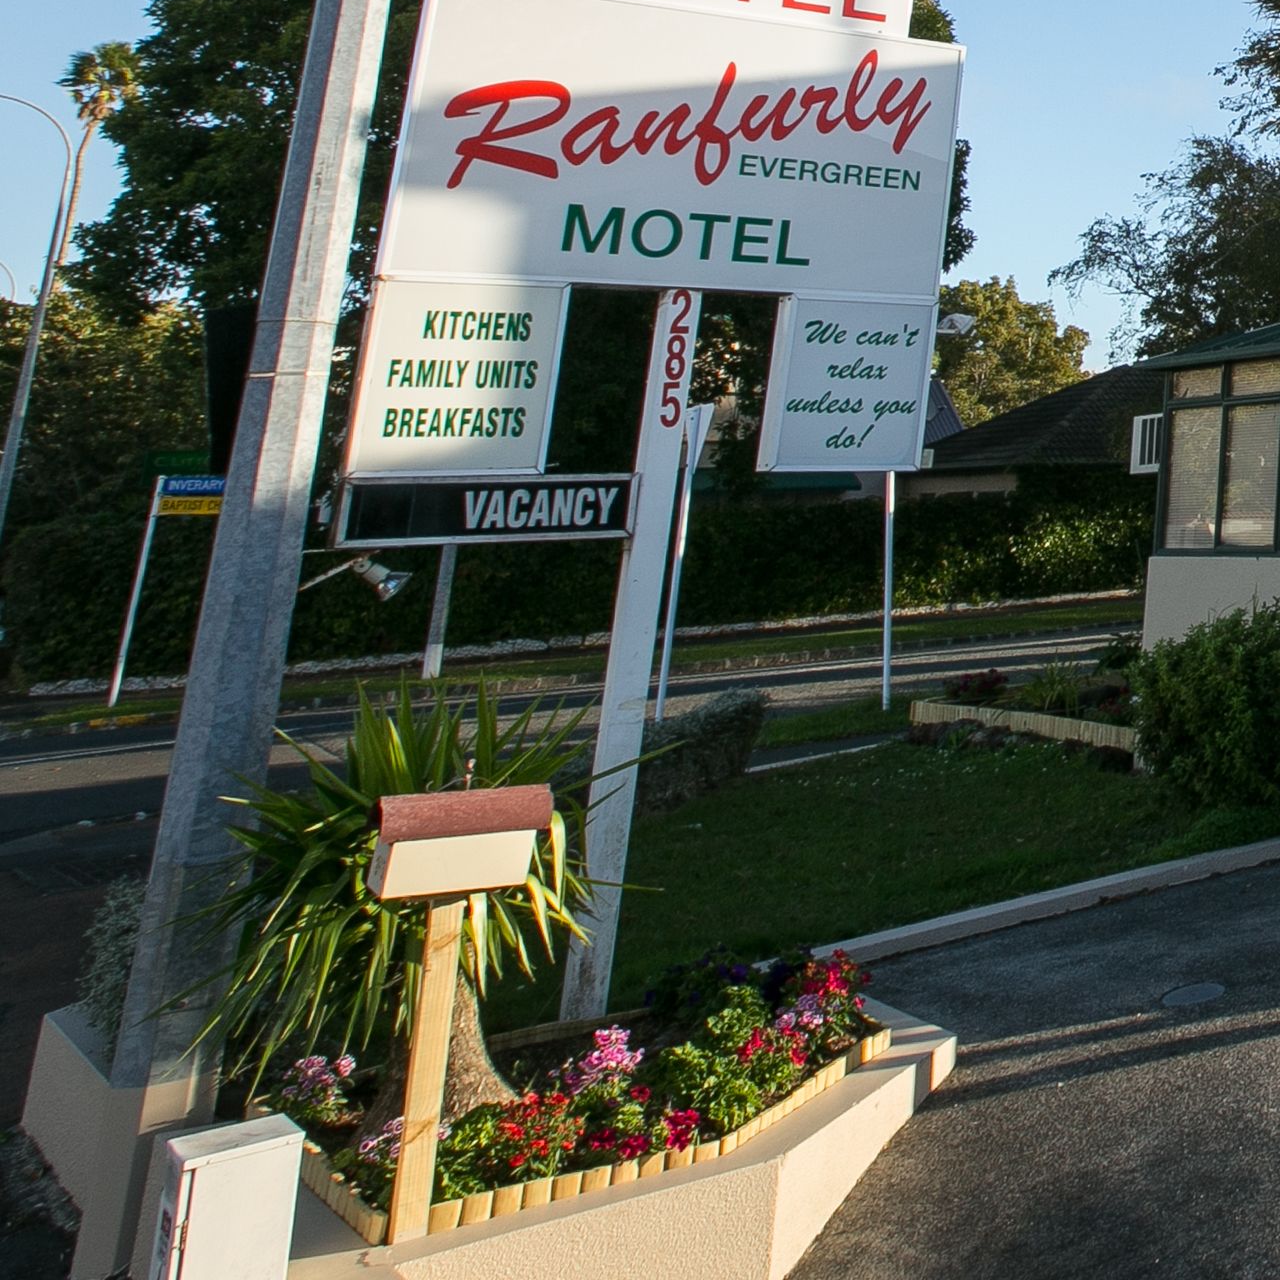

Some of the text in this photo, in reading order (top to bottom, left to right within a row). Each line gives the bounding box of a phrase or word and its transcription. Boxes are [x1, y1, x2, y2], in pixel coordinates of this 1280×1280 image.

[444, 49, 931, 188] Ranfurly
[738, 154, 921, 191] EVERGREEN
[560, 204, 810, 267] MOTEL
[423, 310, 533, 342] KITCHENS
[804, 319, 920, 348] We can't
[386, 359, 538, 390] FAMILY UNITS
[660, 289, 691, 428] 285
[826, 357, 888, 381] relax
[382, 406, 526, 439] BREAKFASTS
[785, 391, 918, 423] unless you
[825, 424, 873, 449] do!
[167, 479, 225, 492] INVERARY
[162, 499, 205, 511] BAPTIST
[464, 487, 619, 529] VACANCY
